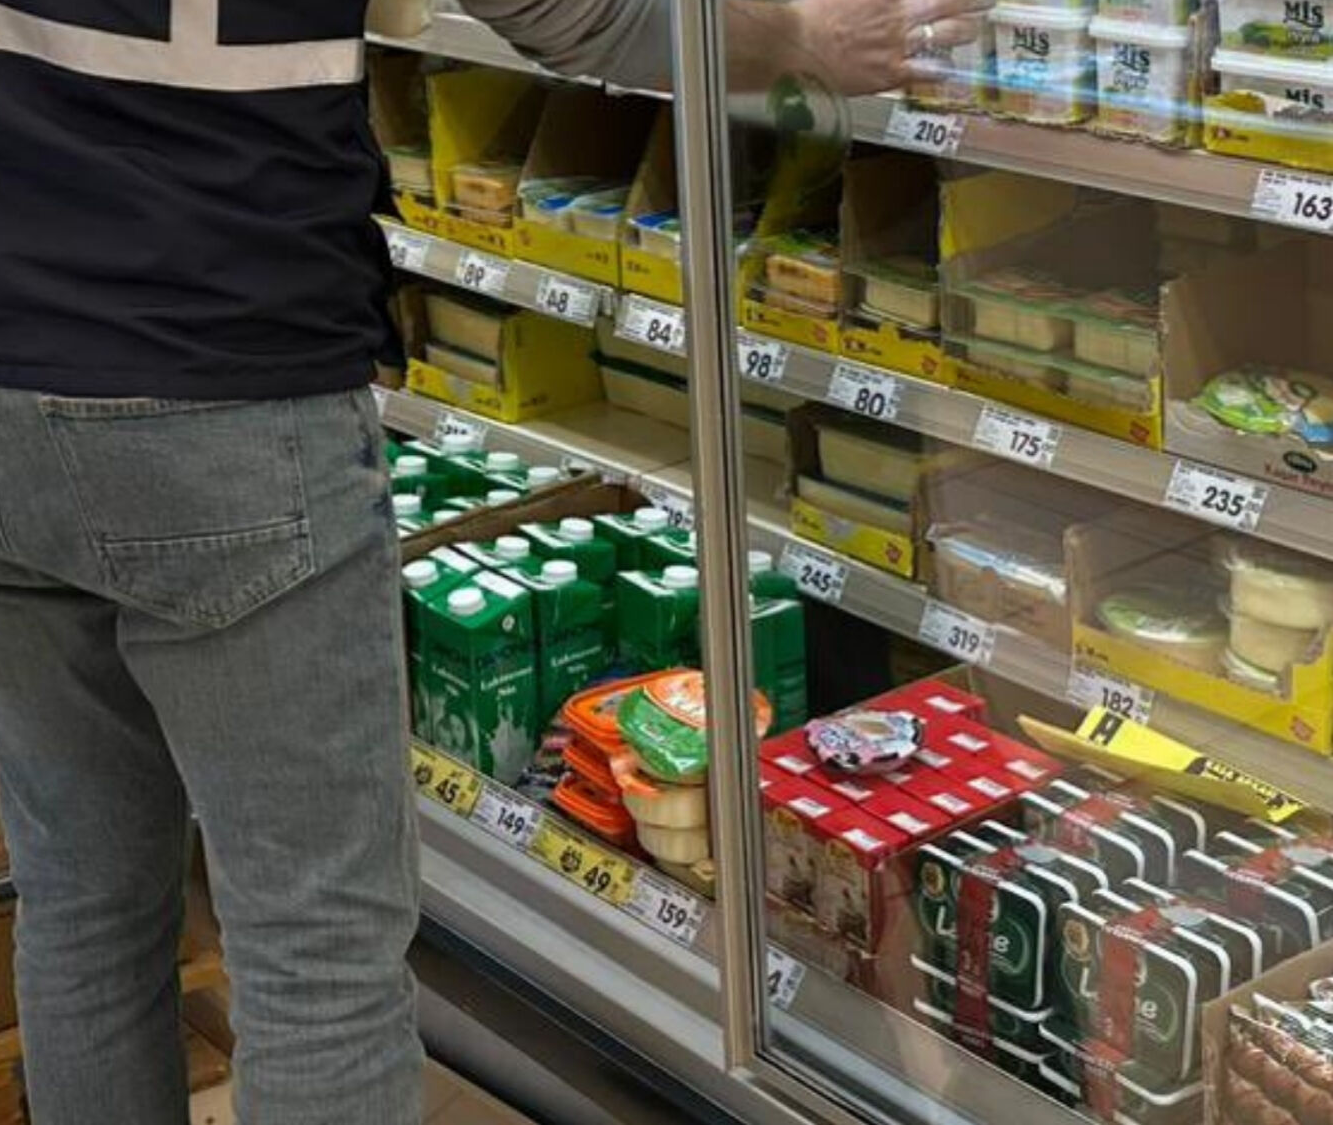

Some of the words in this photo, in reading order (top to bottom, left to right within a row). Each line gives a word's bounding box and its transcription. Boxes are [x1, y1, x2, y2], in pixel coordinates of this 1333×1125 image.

[915, 121, 947, 145] 210
[1292, 192, 1333, 221] 163
[648, 319, 670, 345] 84
[747, 350, 772, 378] 98
[854, 389, 884, 416] 80
[1011, 431, 1042, 457] 175
[1201, 486, 1246, 516] 235
[801, 563, 831, 593] 245
[948, 629, 979, 653] 319
[1101, 687, 1133, 717] 182
[434, 778, 458, 805] 45
[497, 808, 524, 834] 149
[583, 867, 611, 893] 49
[656, 898, 687, 927] 159
